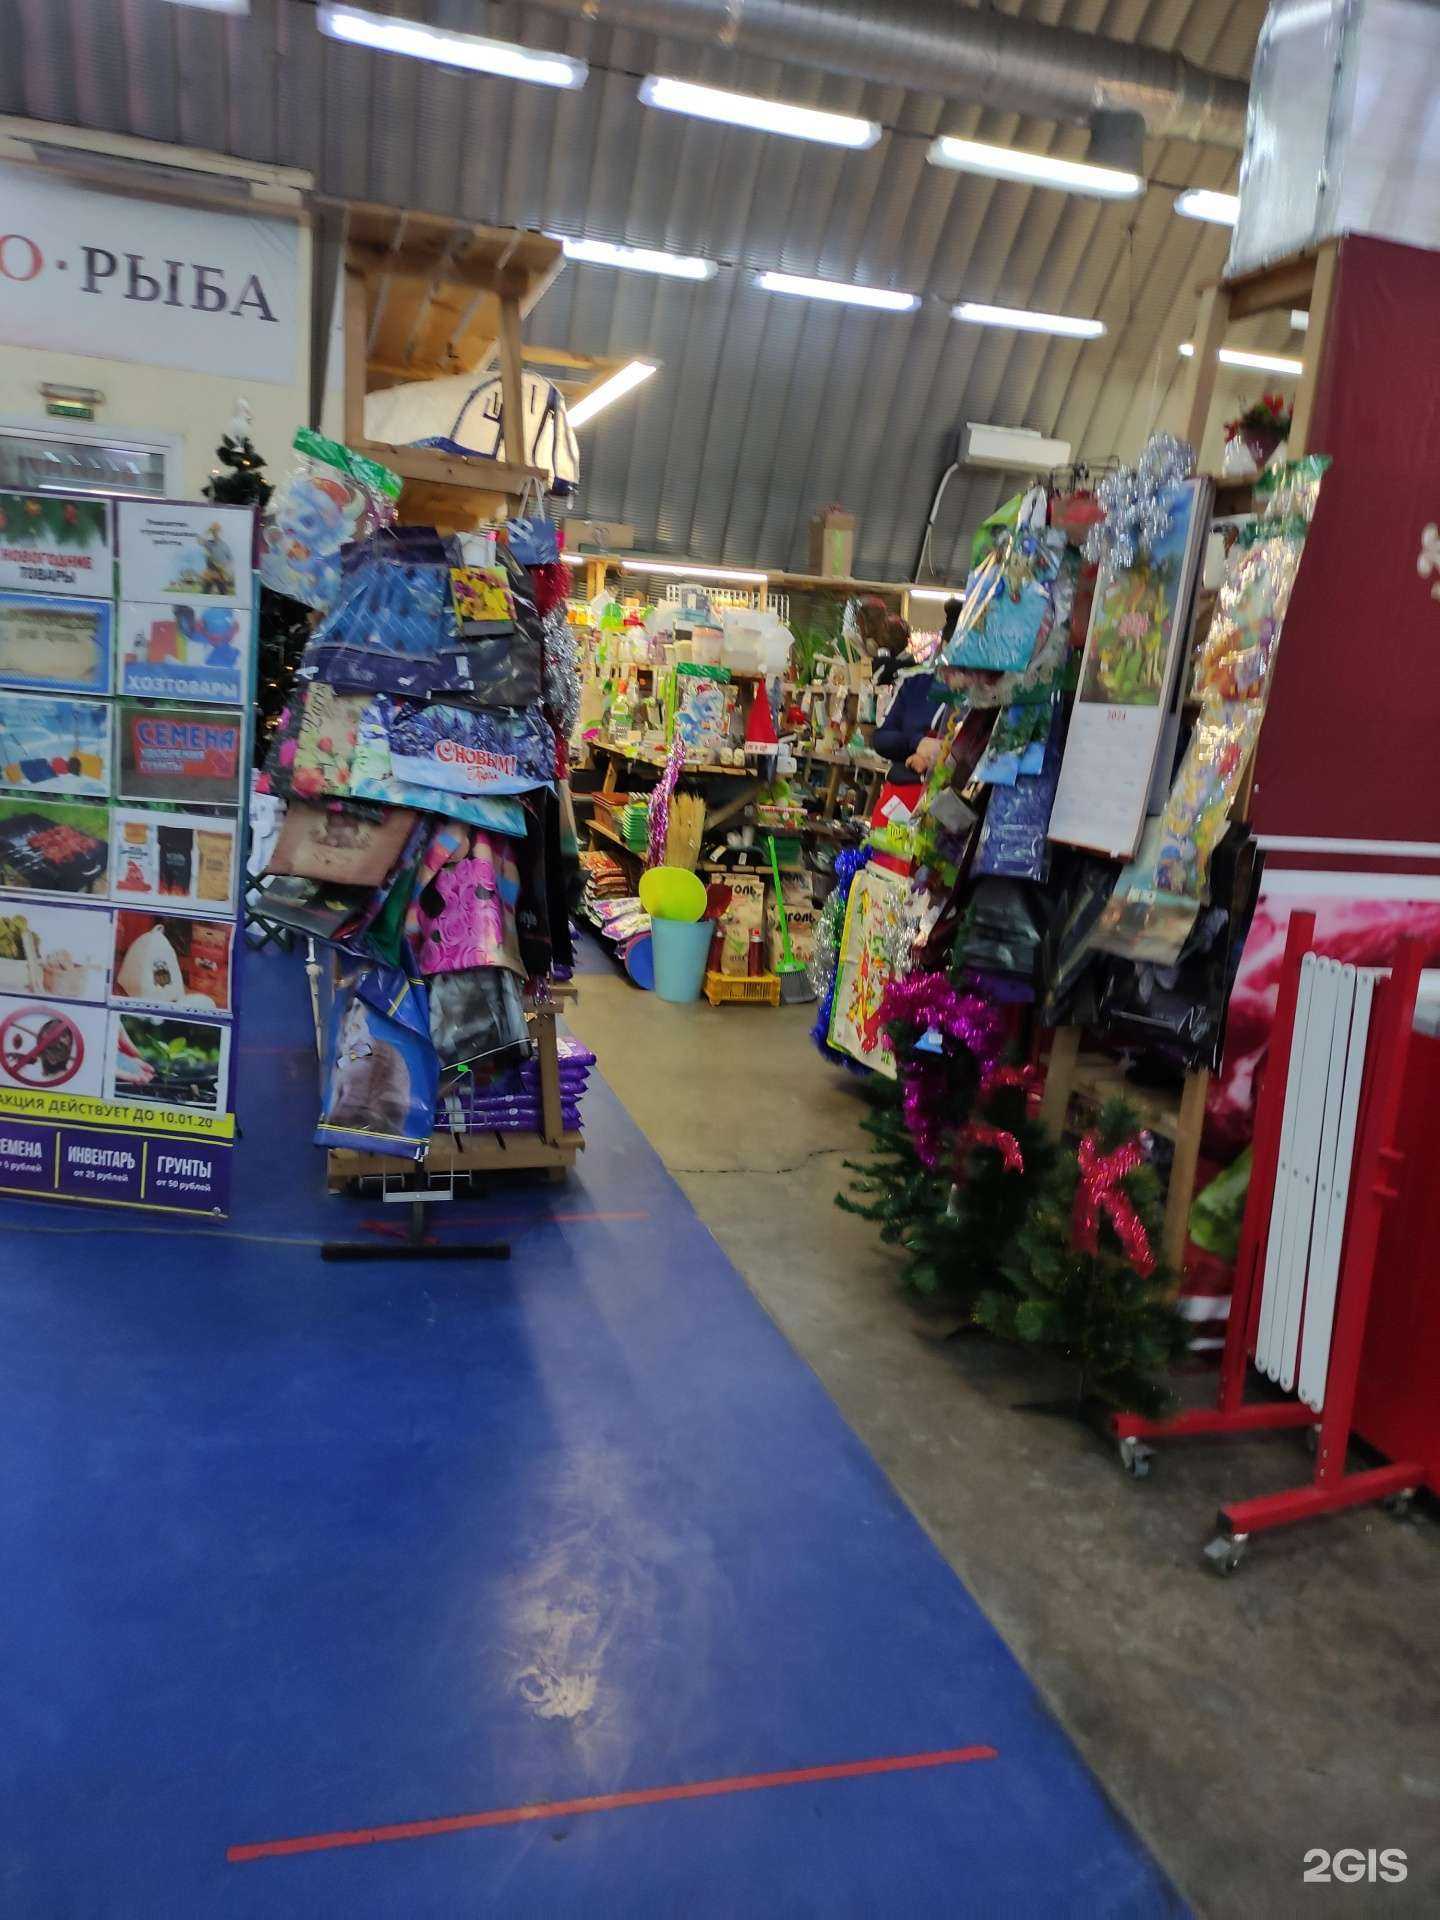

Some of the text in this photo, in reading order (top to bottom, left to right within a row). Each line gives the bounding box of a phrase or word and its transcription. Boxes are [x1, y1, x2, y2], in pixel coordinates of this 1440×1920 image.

[128, 675, 237, 697] ХОЗТОВАРЫ
[136, 719, 237, 752] СЕМЕНА
[0, 1094, 213, 1128] АКЦИЯ ДЕЙСТВУЕТ ДО 10.01.20
[0, 1137, 42, 1158] ЕМЕНА
[67, 1145, 136, 1170] ИНВЕНТАРЬ
[156, 1155, 212, 1179] ГРУНТЫ
